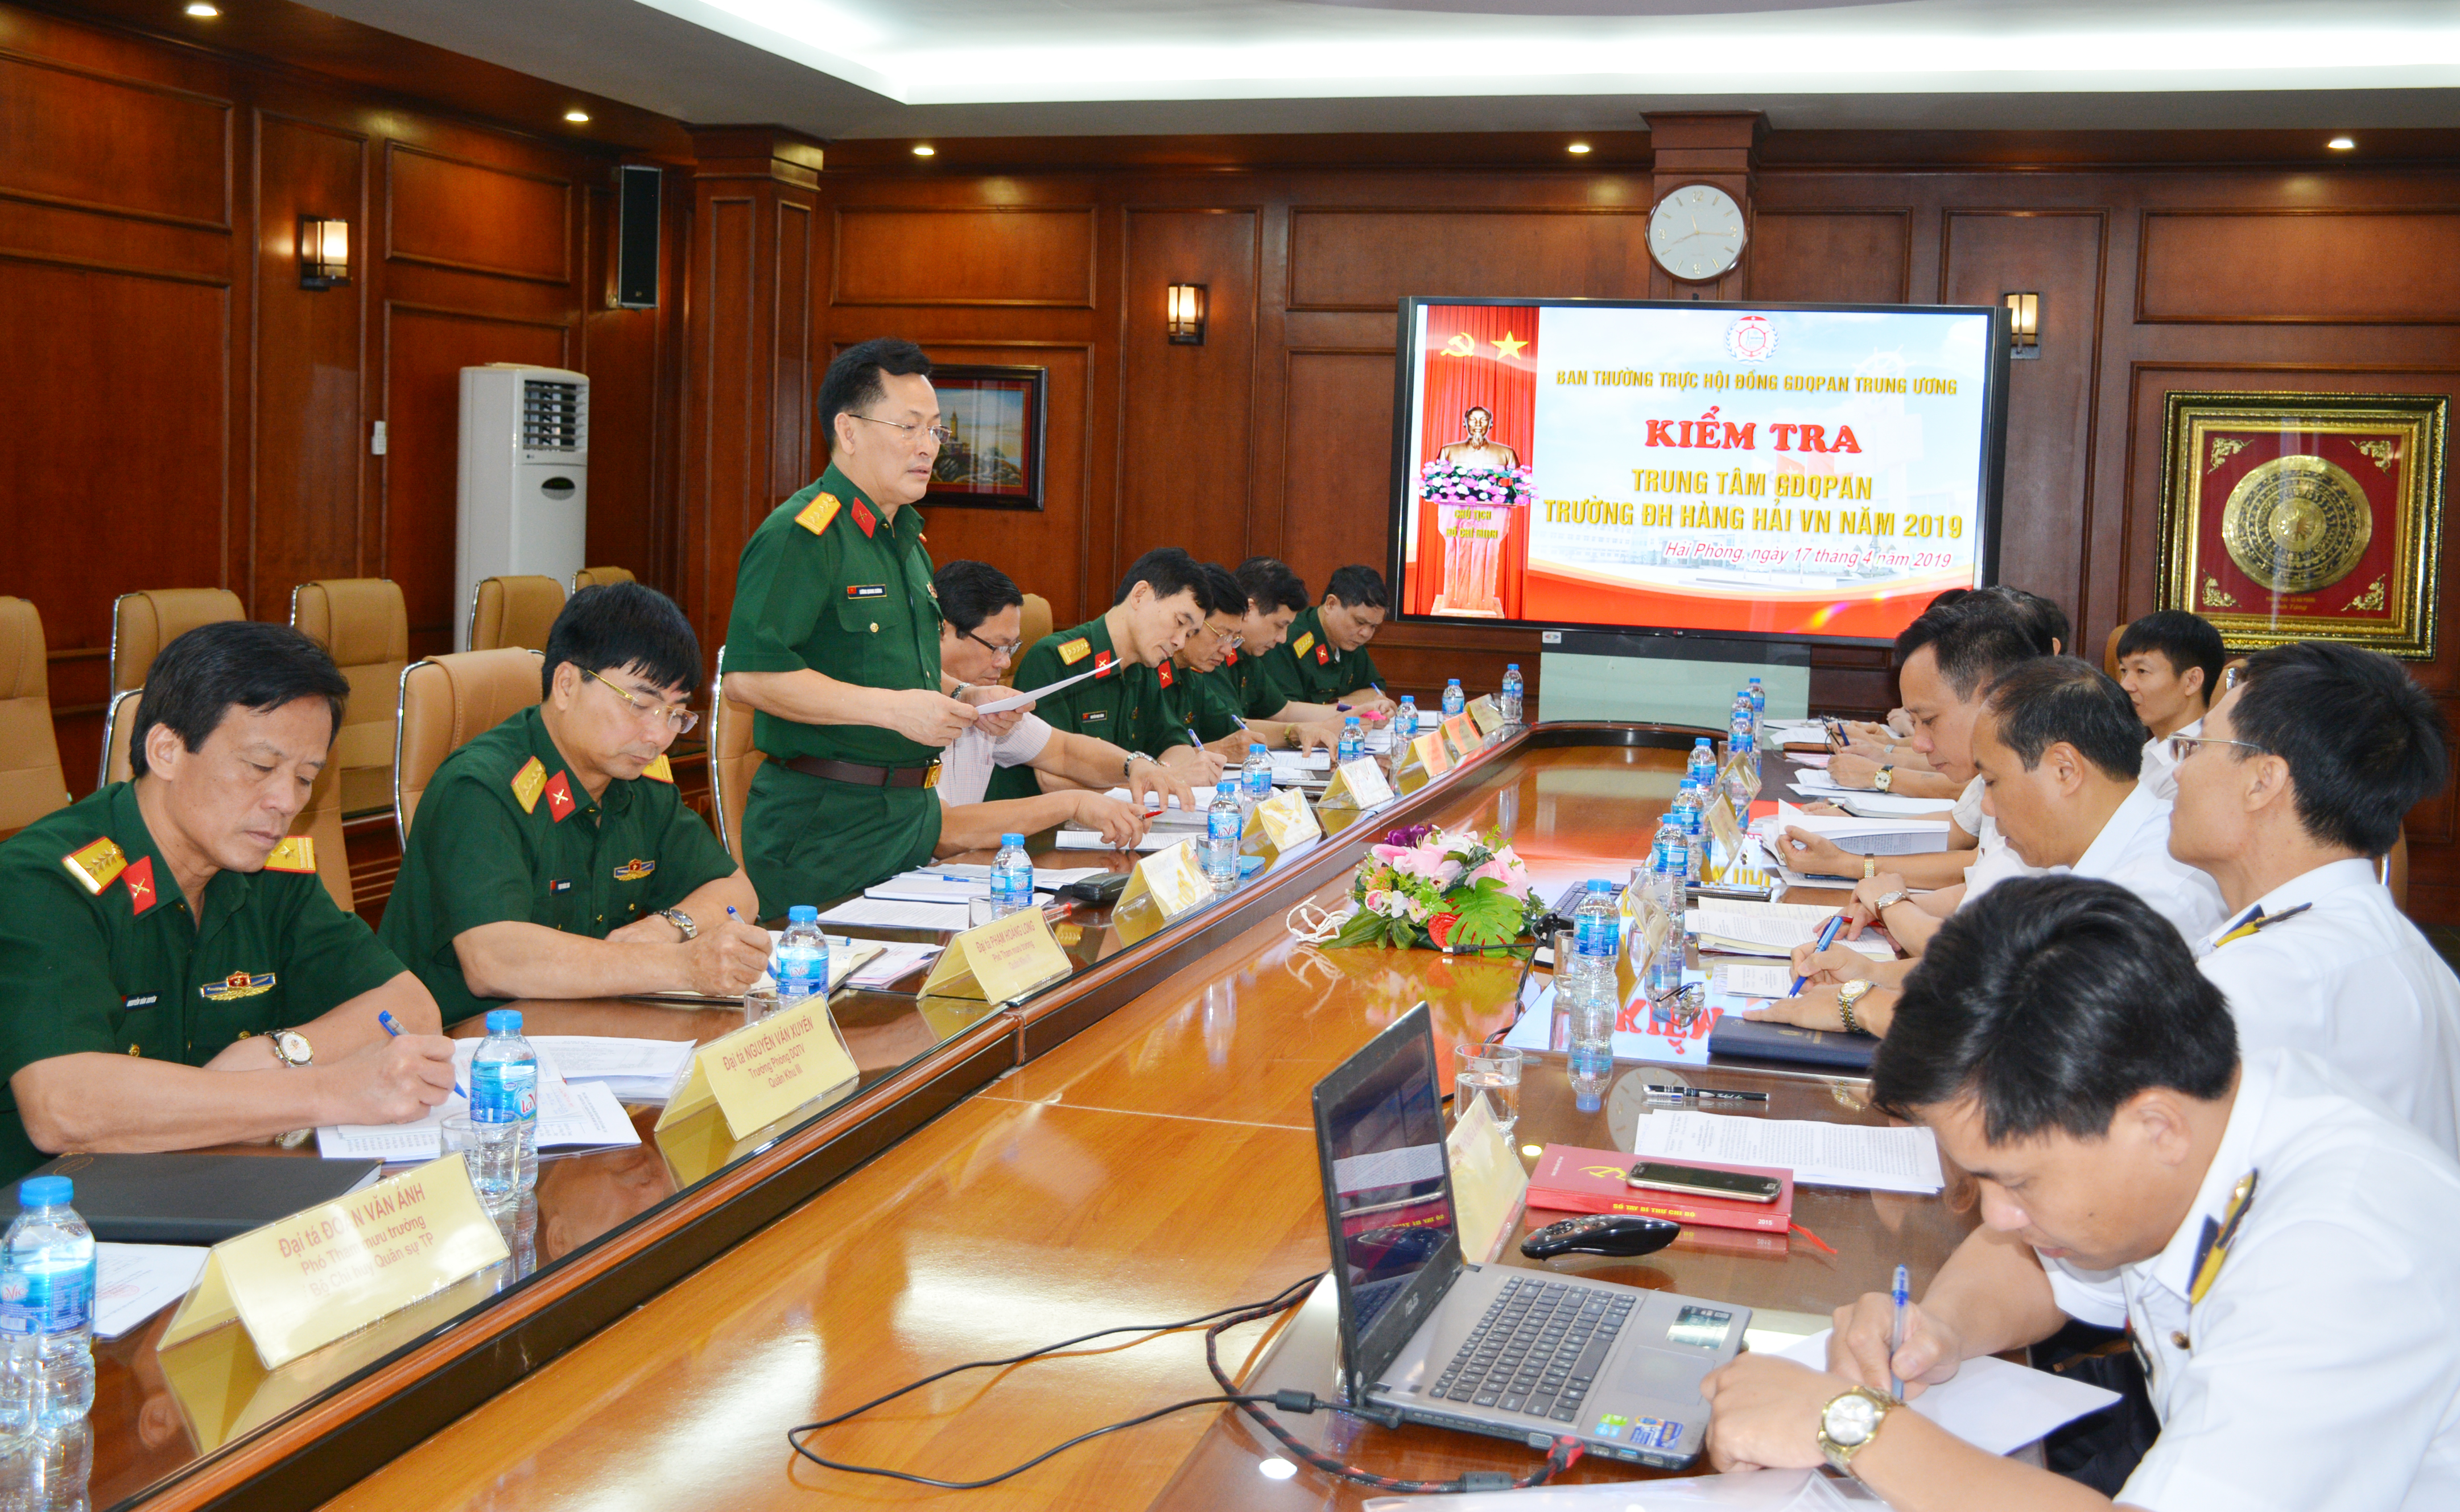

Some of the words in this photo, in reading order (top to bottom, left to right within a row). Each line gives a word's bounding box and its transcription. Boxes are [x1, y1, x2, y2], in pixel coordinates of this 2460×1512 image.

[1556, 370, 1587, 385] BAN
[1593, 367, 1653, 387] THƯỜNG
[1659, 371, 1698, 392] TRỰC
[1703, 370, 1730, 393] HỘI
[1735, 369, 1778, 391] ĐỒNG
[1784, 374, 1848, 394] GDQPAN
[1854, 377, 1907, 394] TRUNG
[1913, 377, 1958, 395] ƯƠNG
[1645, 405, 1757, 450] KIỂM
[1769, 423, 1863, 454] TRA
[1632, 468, 1708, 494] TRUNG
[1716, 466, 1766, 496] TÂM
[1774, 473, 1872, 501] GDQPAN
[1473, 509, 1492, 521] TỊCH
[1543, 494, 1634, 526] TRƯỜNG
[1642, 502, 1673, 527] ĐH
[1680, 499, 1744, 530] HÀNG
[1752, 498, 1792, 532] HẢI
[1799, 509, 1831, 534] VN
[1839, 506, 1895, 535] NĂM
[1903, 513, 1962, 539] 2019
[1476, 529, 1498, 538] MINH
[1666, 540, 1691, 557] Hải
[1750, 546, 1789, 564] ngày
[1794, 547, 1813, 561] 17
[1815, 549, 1859, 567] tháng
[1862, 550, 1873, 564] 4
[1876, 551, 1910, 566] năm
[1913, 552, 1953, 568] 2019
[990, 932, 1006, 947] PHẠM
[1004, 925, 1023, 940] HOÀNG
[1021, 920, 1035, 934] LONG
[723, 1054, 738, 1071] Đại
[736, 1048, 746, 1064] tá
[744, 1034, 777, 1060] NGUYỄN
[774, 1027, 791, 1046] VĂN
[771, 1054, 792, 1068] Phòng
[769, 1073, 786, 1088] Quân
[783, 1067, 797, 1081] Khu
[278, 1232, 306, 1258] Đại
[306, 1225, 322, 1247] tá
[364, 1194, 396, 1222] VĂN
[397, 1182, 426, 1210] ÁNH
[1613, 1201, 1624, 1210] SỔ
[1683, 1209, 1696, 1218] BỘ
[300, 1254, 327, 1276] Phó
[362, 1231, 389, 1250] mưu
[388, 1215, 427, 1240] trưởng
[374, 1247, 405, 1268] Quân
[405, 1241, 420, 1255] sự
[418, 1232, 434, 1249] TP
